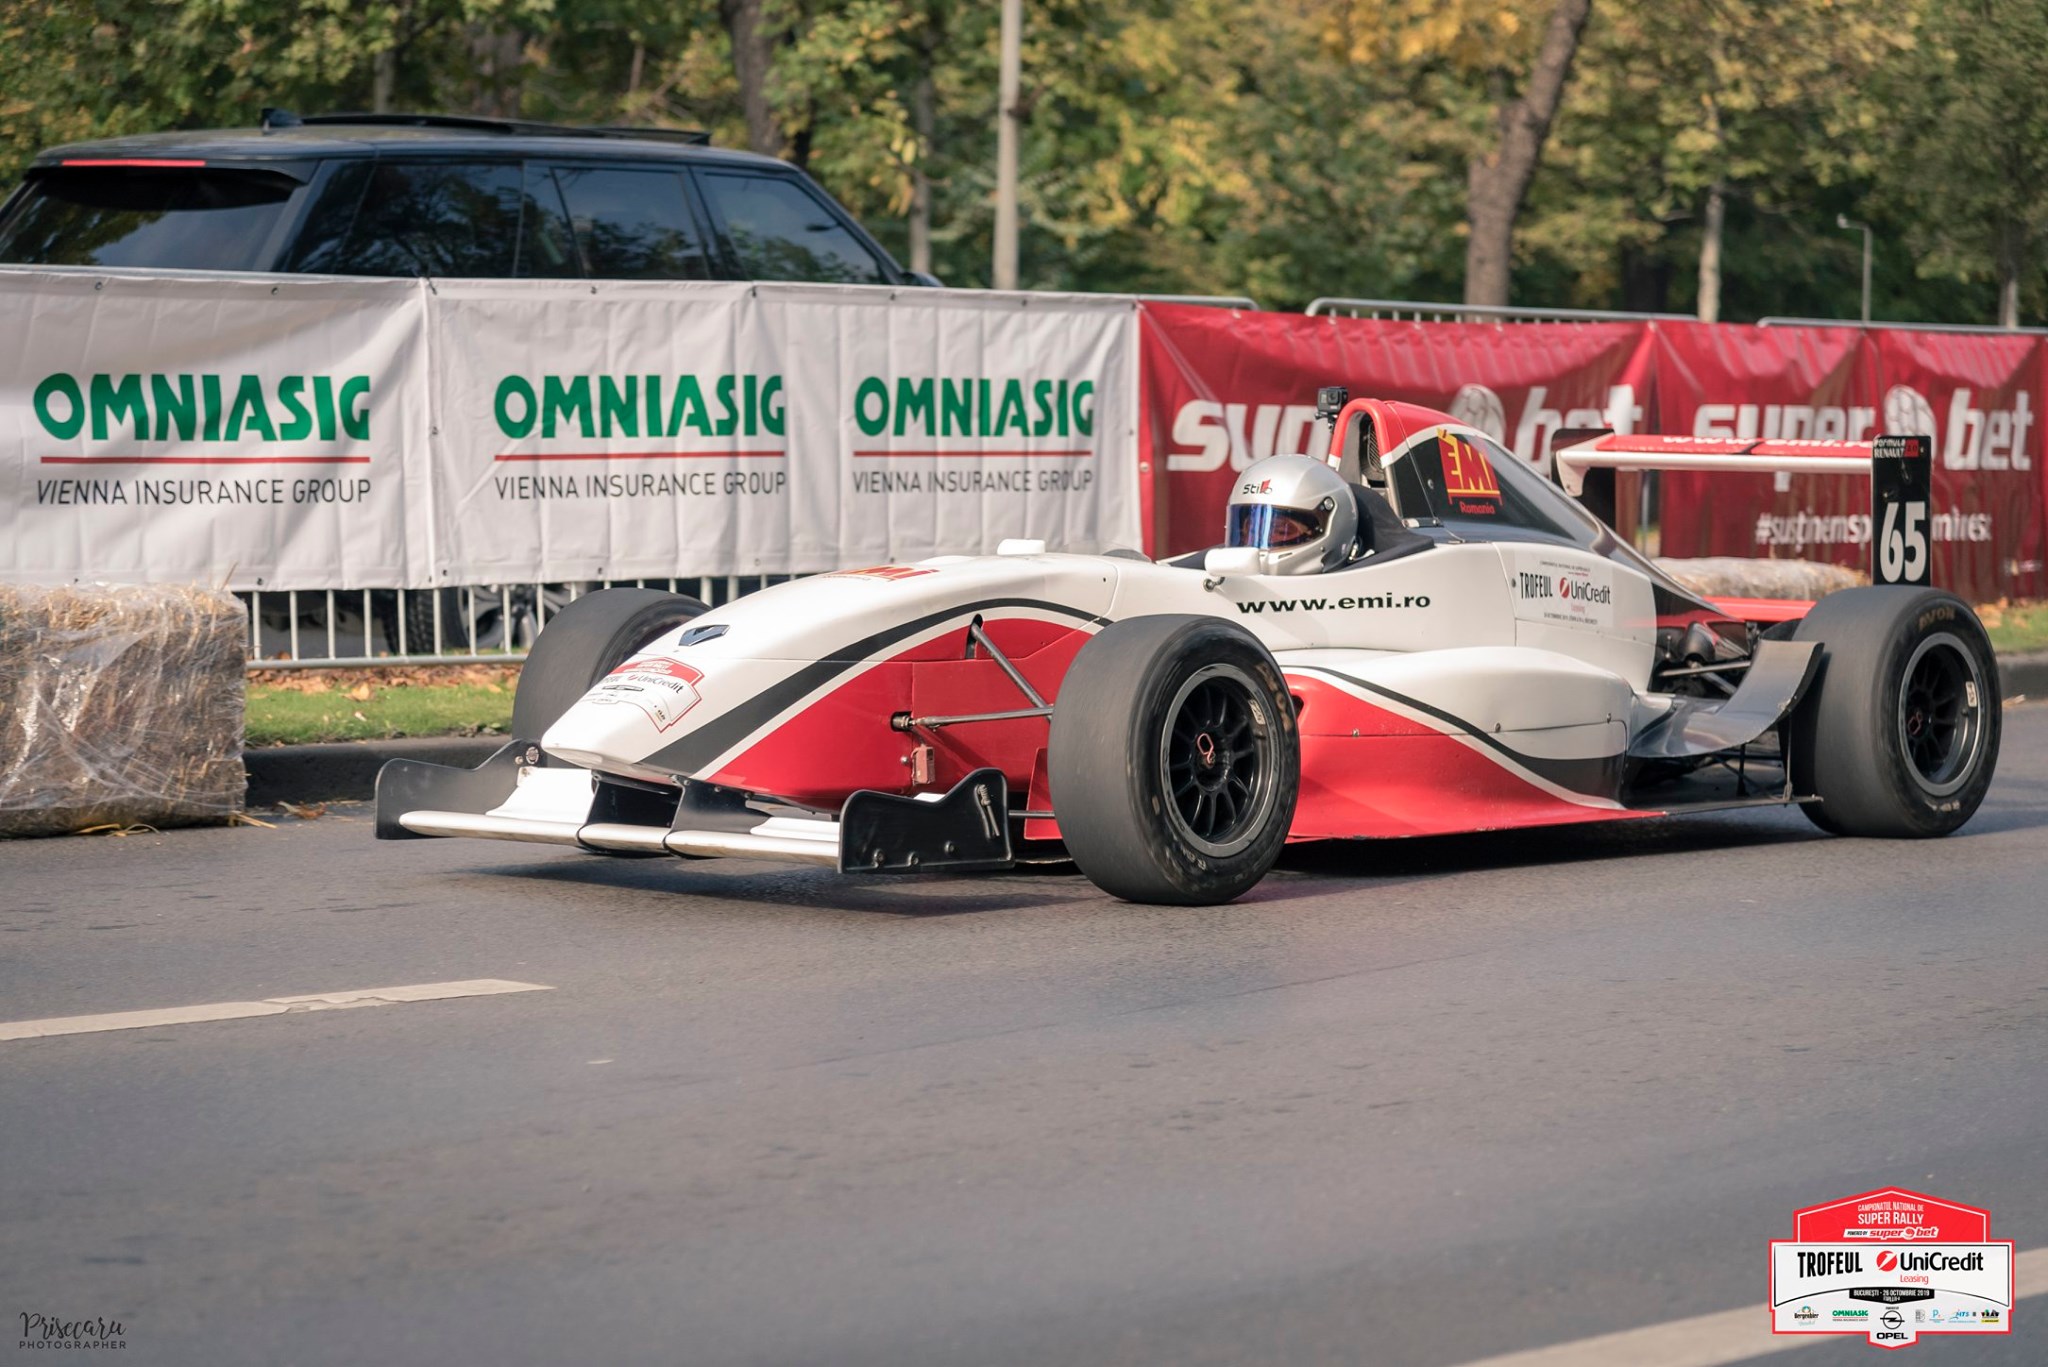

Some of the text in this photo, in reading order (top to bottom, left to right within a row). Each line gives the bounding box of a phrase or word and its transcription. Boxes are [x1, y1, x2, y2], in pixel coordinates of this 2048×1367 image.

[33, 373, 371, 441] OMNIASIG
[494, 375, 785, 438] OMNIASIG
[854, 377, 1094, 437] OMNIASIG
[37, 479, 372, 505] VIENNA INSURANCE GROUP
[495, 472, 787, 500] VIENNA INSURANCE GROUP
[853, 470, 1094, 495] VIENNA INSURANCE GROUP
[1459, 501, 1496, 515] Romania
[1879, 501, 1926, 583] 65
[1235, 590, 1432, 615] www.emi.ro
[1519, 571, 1611, 605] TROFEUL UniCredit
